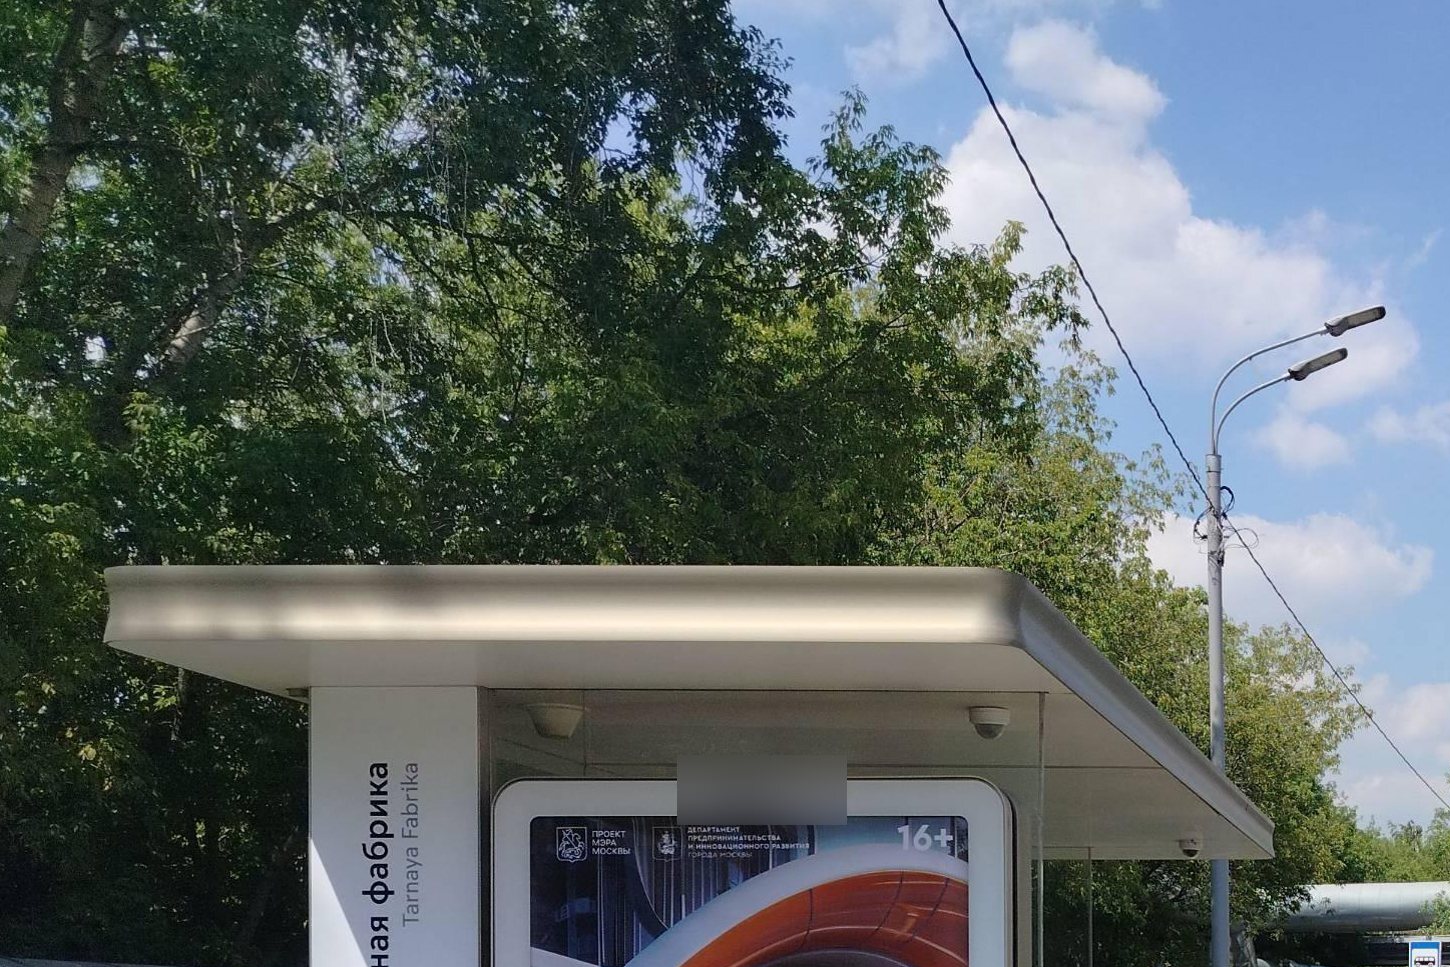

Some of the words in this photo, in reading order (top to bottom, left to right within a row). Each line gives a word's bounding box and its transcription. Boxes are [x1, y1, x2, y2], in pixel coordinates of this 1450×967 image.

[400, 762, 419, 839] Fabrika
[361, 762, 395, 904] фабрика
[591, 830, 627, 838] ПРОЕКТ
[591, 847, 631, 855] МОСКВЫ
[897, 825, 954, 851] 16+
[403, 847, 423, 927] Tarnaya
